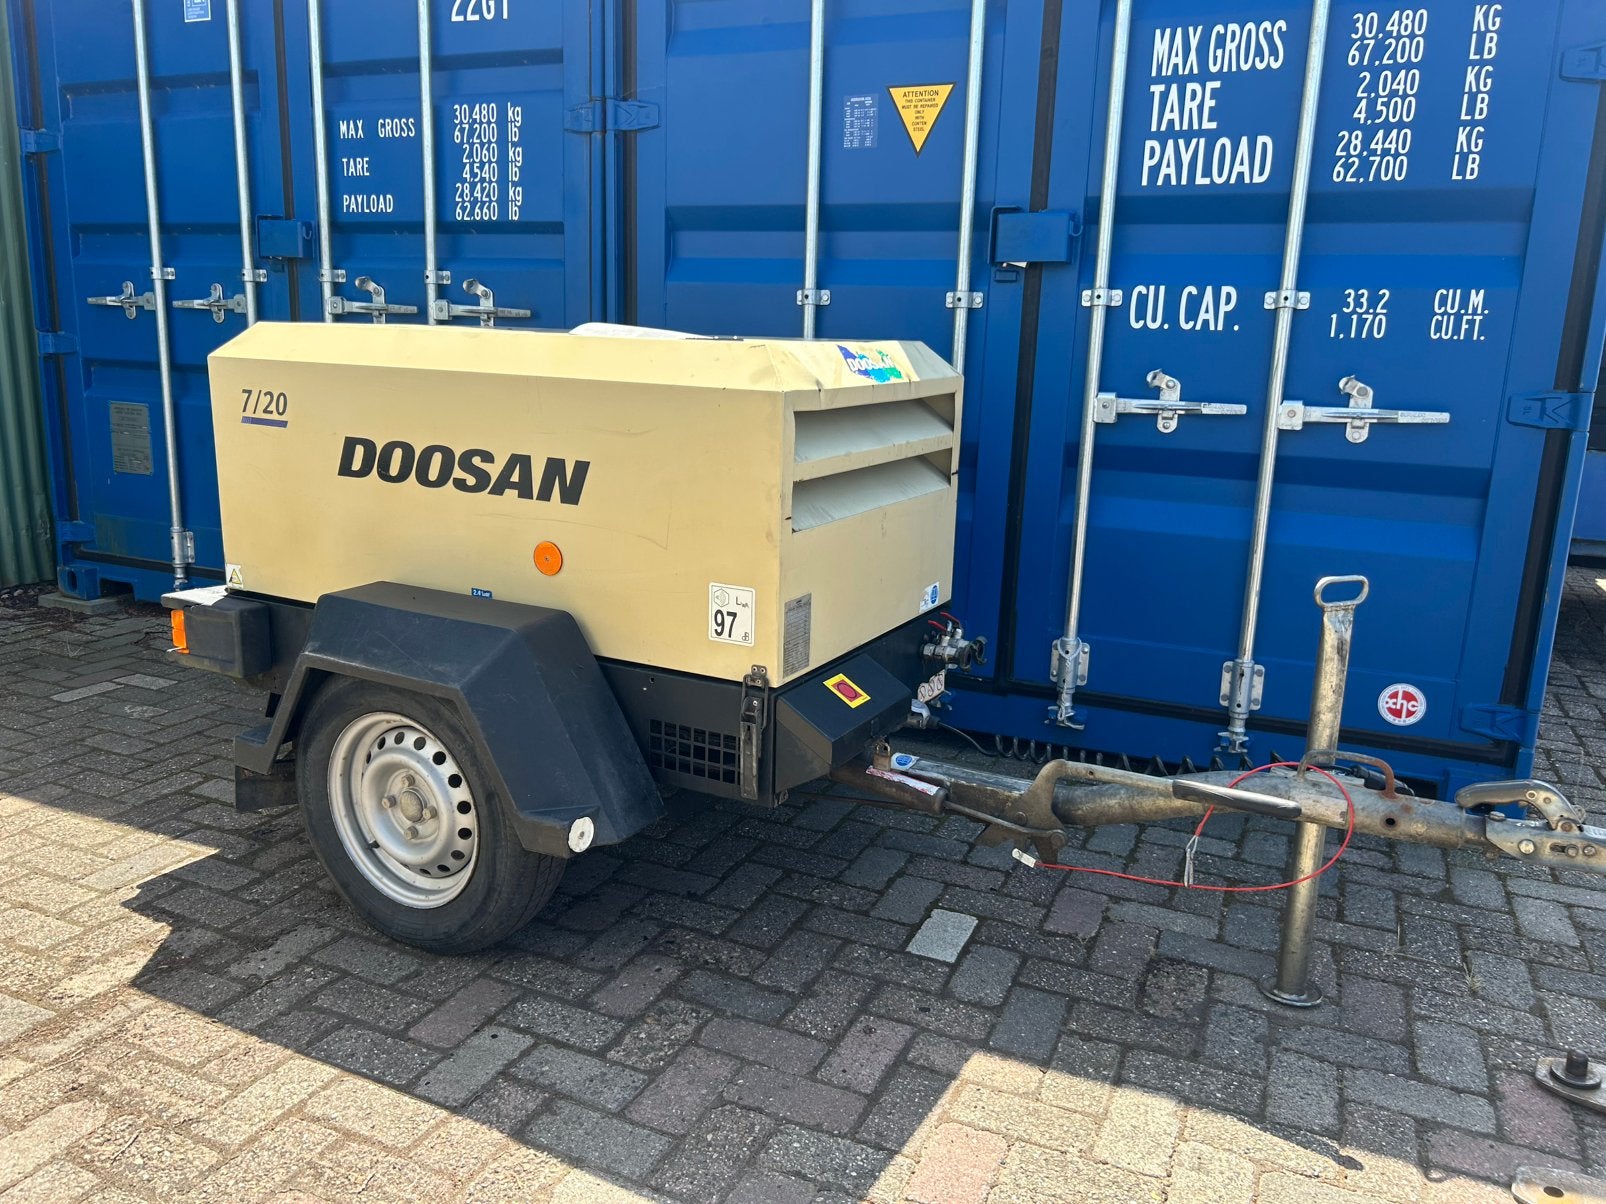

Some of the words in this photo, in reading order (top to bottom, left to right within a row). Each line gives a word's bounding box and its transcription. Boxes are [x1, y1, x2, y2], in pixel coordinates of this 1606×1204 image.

[1351, 8, 1428, 39] 30,480
[1473, 5, 1502, 32] KG
[1151, 25, 1203, 77] MAX
[1209, 20, 1287, 73] GROSS
[1347, 36, 1424, 67] 67,200
[1469, 33, 1498, 60] LB
[903, 90, 939, 98] ATTENTION
[1356, 68, 1420, 98] 2,040
[1465, 65, 1494, 93] KG
[453, 103, 497, 124] 30,480
[507, 102, 522, 126] kg
[1149, 80, 1221, 132] TARE
[1353, 96, 1416, 126] 4,500
[1460, 93, 1489, 120] LB
[339, 119, 364, 139] MAX
[378, 118, 416, 138] GROSS
[454, 123, 498, 144] 67,200
[508, 122, 520, 142] lb
[1335, 128, 1412, 157] 28,440
[1456, 126, 1485, 153] KG
[342, 157, 370, 177] TARE
[462, 144, 498, 163] 2,060
[508, 143, 523, 166] kg
[1141, 135, 1273, 186] PAYLOAD
[1332, 155, 1408, 183] 62,700
[1451, 153, 1480, 180] LB
[462, 163, 498, 182] 4,540
[508, 162, 520, 182] lb
[343, 194, 394, 213] PAYLOAD
[455, 182, 498, 202] 28,420
[508, 182, 523, 206] kg
[455, 201, 498, 221] 62,660
[508, 201, 520, 221] lb
[1129, 285, 1169, 331] CU.
[1179, 285, 1239, 331] CAP.
[1342, 288, 1390, 314] 33.2
[1433, 288, 1489, 314] CU.M.
[1330, 313, 1387, 339] 1,170
[1430, 314, 1486, 341] CU.FT.
[241, 388, 288, 417] 7/20
[337, 435, 592, 507] DOOSAN
[714, 609, 738, 638] 97
